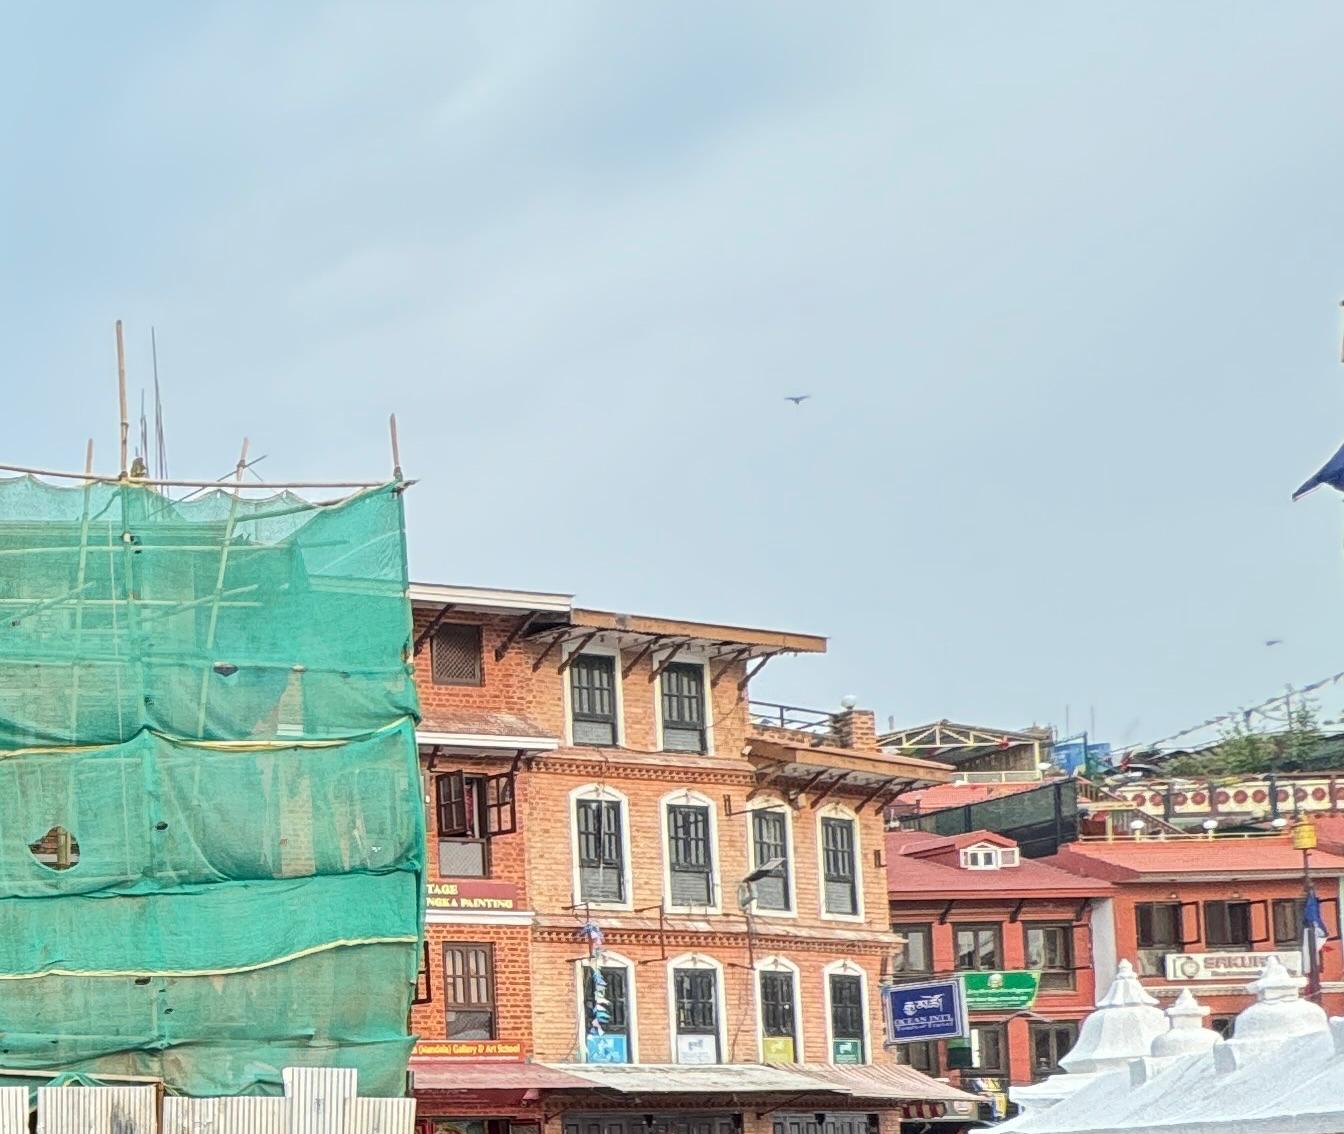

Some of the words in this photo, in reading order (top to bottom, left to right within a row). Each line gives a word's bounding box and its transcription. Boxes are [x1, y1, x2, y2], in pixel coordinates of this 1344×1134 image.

[460, 898, 513, 909] PAINTING
[452, 1044, 477, 1055] Gallery
[485, 1044, 496, 1054] Art
[497, 1043, 521, 1054] School
